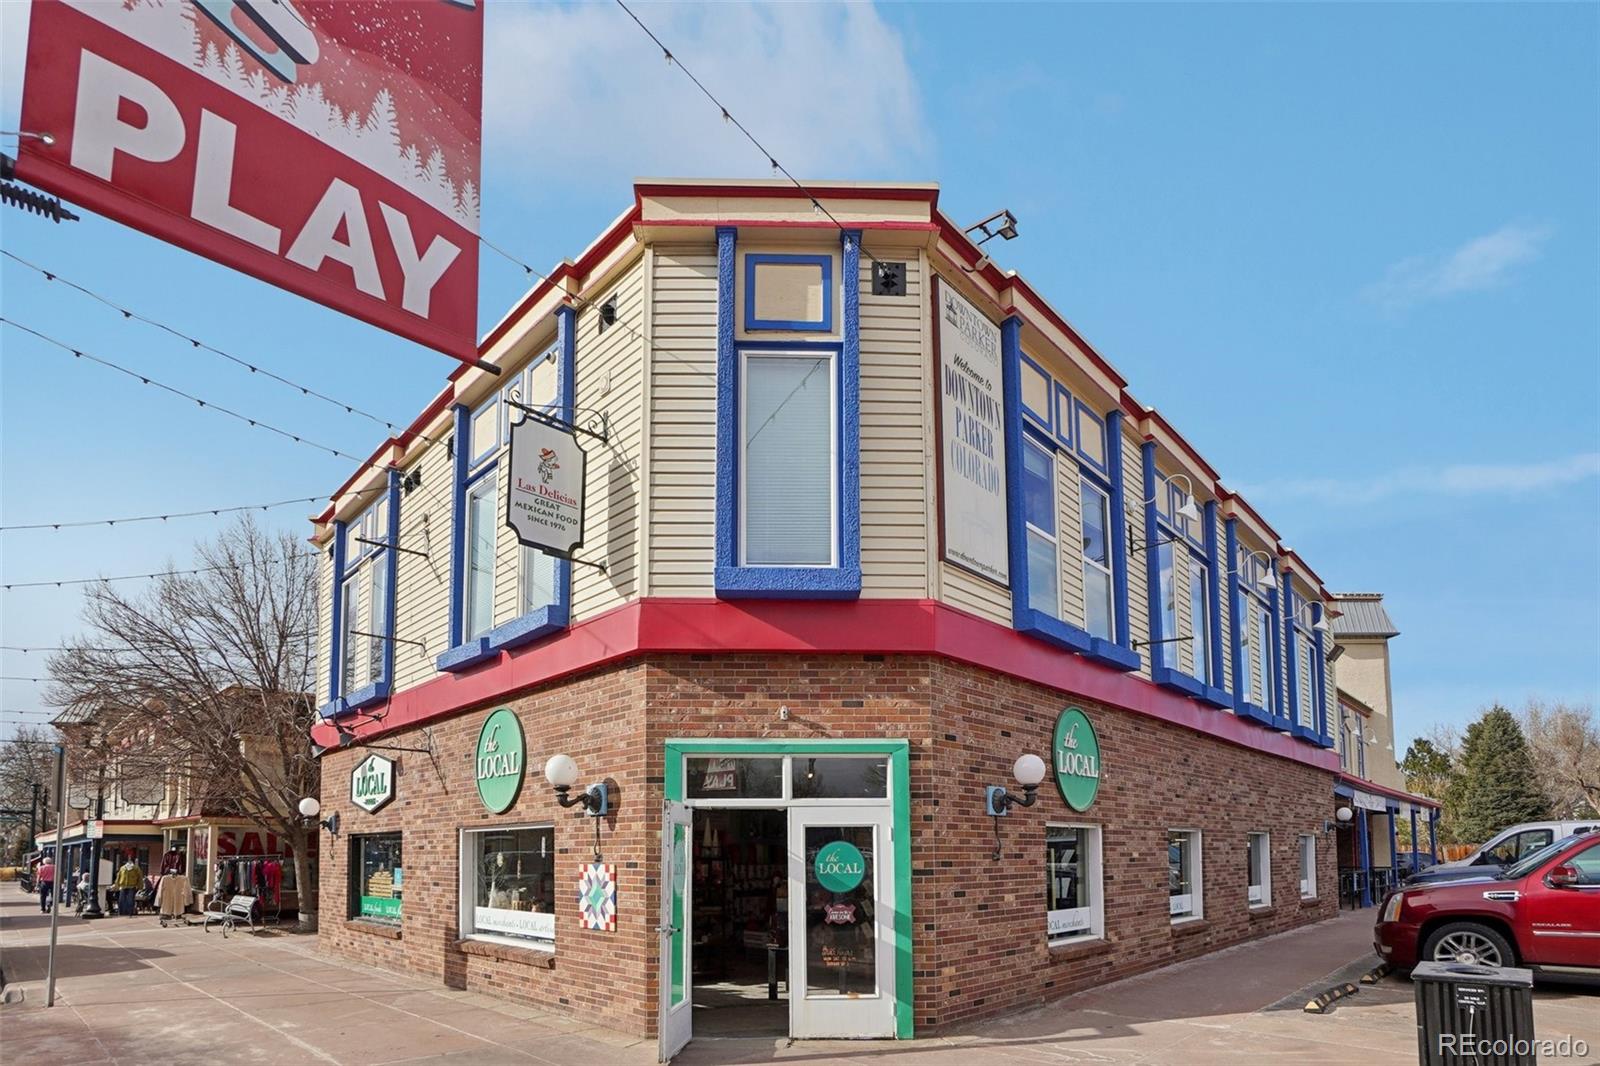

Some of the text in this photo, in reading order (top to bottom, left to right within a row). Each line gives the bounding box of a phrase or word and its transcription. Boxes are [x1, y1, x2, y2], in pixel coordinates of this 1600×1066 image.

[70, 47, 462, 320] PLAY
[944, 289, 997, 342] DOWNTOWN
[959, 315, 996, 356] PARKER
[953, 353, 984, 386] Welcome
[945, 364, 1001, 431] DOWNTOWN
[955, 406, 994, 461] PARKER
[951, 439, 1000, 497] COLORADO
[517, 478, 577, 506] Las Delicias
[534, 498, 561, 511] GREAT
[514, 501, 578, 526] MEXICAN FOOD
[527, 514, 566, 532] SINCE 1976
[1064, 722, 1079, 749] the
[477, 751, 520, 780] LOCAL
[1057, 749, 1099, 778] LOCAL
[356, 772, 387, 798] LOCAL
[818, 862, 862, 874] LOCAL
[826, 847, 840, 862] the
